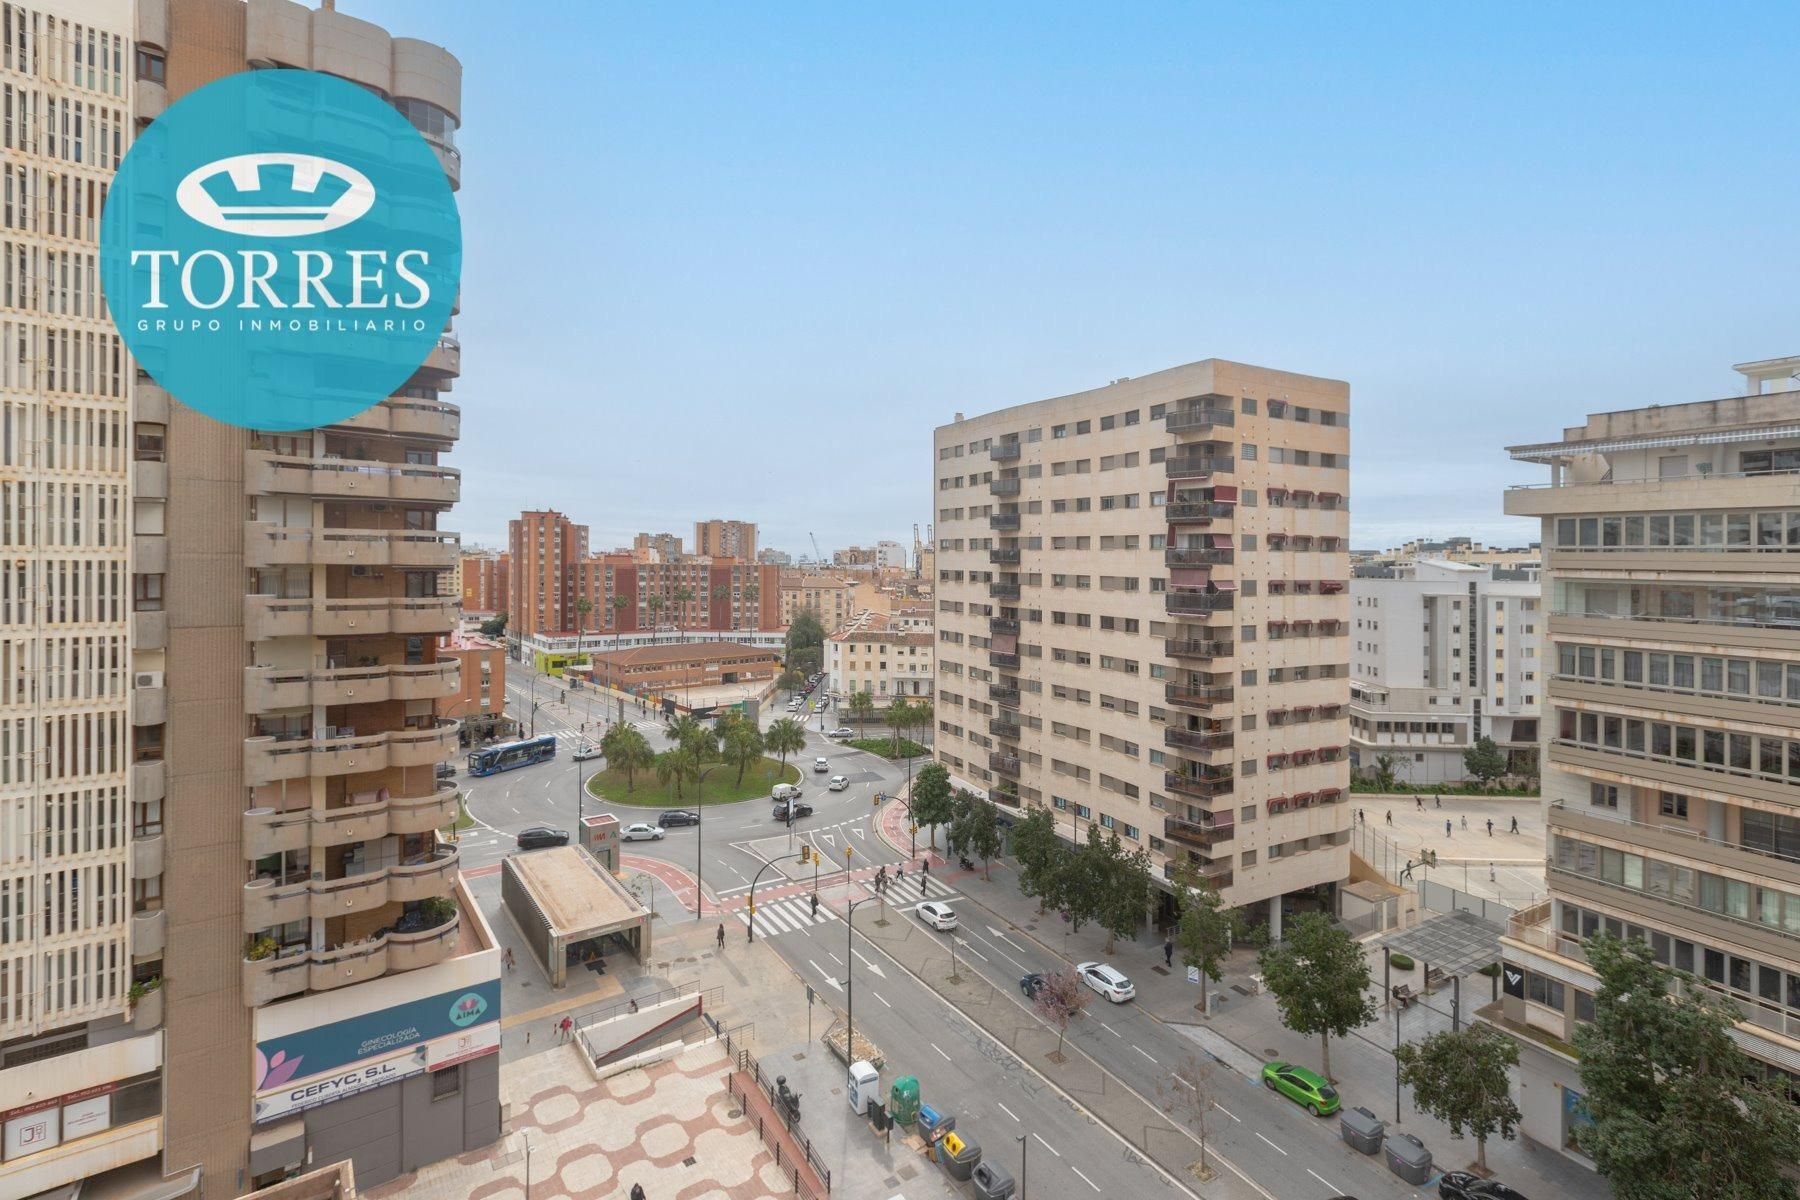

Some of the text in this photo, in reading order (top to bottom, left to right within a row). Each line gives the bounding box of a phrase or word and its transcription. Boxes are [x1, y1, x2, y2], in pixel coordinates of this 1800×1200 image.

[456, 1008, 481, 1020] AIMA
[357, 1032, 421, 1055] ESPECIALIZADA
[291, 1073, 361, 1101] CEFYC,
[365, 1064, 396, 1079] S.L.
